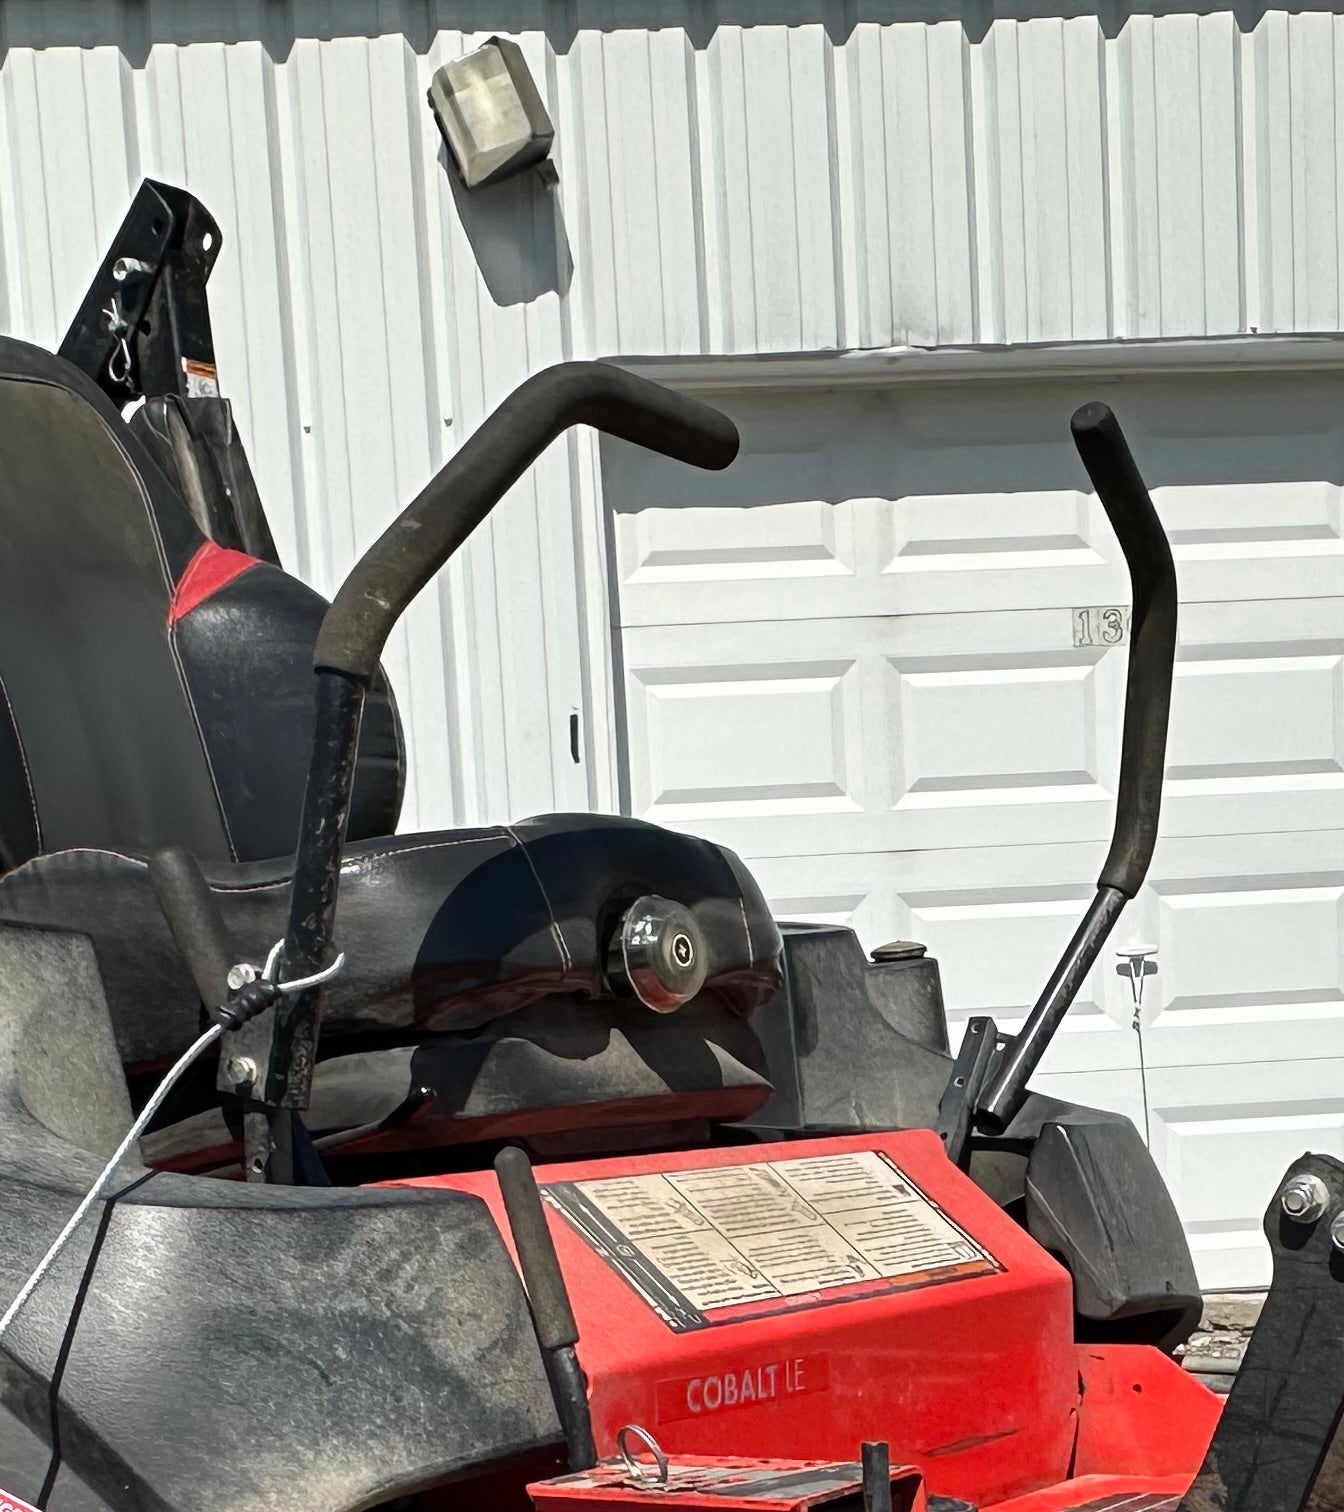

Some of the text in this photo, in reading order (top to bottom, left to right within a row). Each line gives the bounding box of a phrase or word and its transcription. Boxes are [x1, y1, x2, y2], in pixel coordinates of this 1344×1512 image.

[1078, 608, 1132, 647] 13
[687, 1359, 806, 1413] COBALT LE
